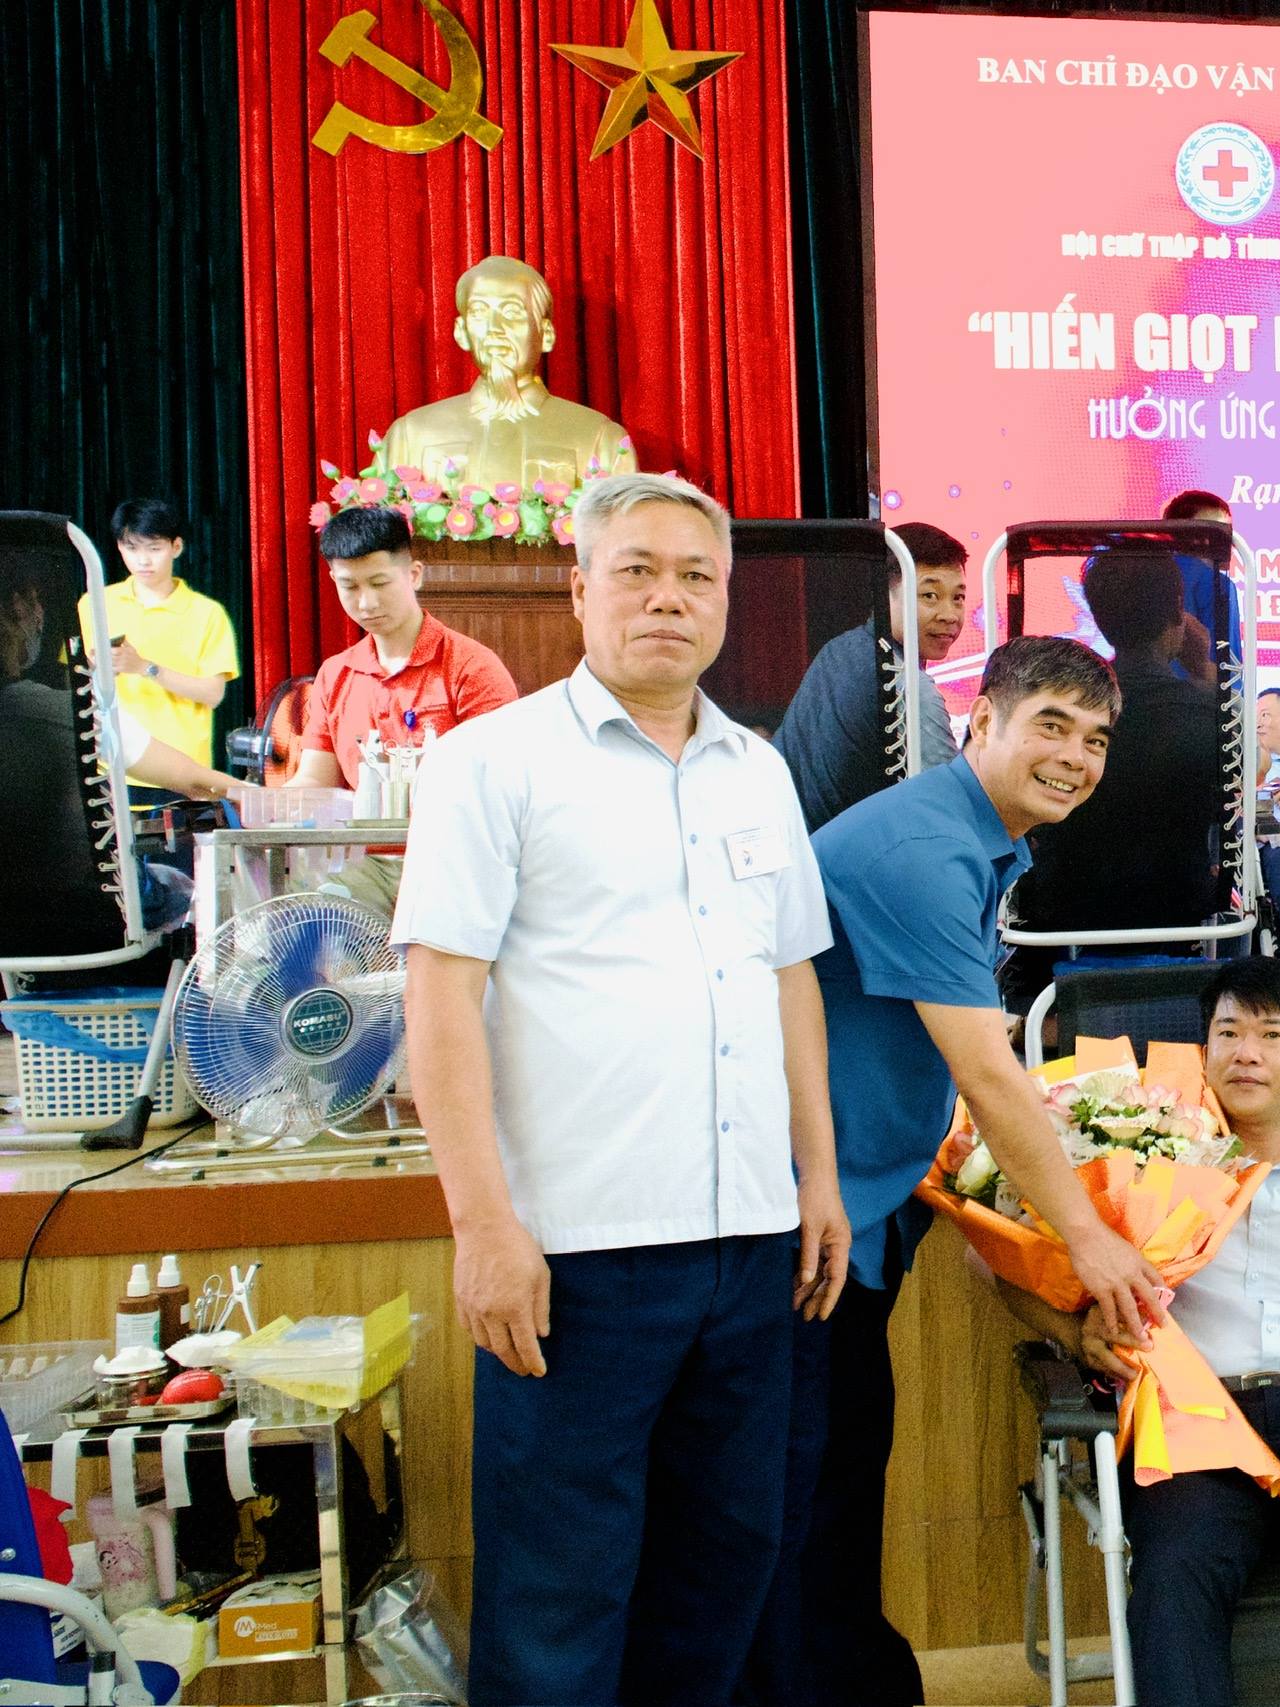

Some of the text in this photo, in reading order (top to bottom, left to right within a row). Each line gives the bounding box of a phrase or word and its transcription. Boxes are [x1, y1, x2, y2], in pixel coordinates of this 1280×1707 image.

[977, 57, 1047, 84] BAN
[1055, 54, 1117, 86] CHỈ
[1125, 62, 1198, 95] ĐẠO
[1205, 62, 1275, 97] VẬN
[1133, 312, 1258, 383] GIỌT
[1087, 386, 1206, 439] HƯỞNG
[1219, 391, 1276, 440] ỨNG
